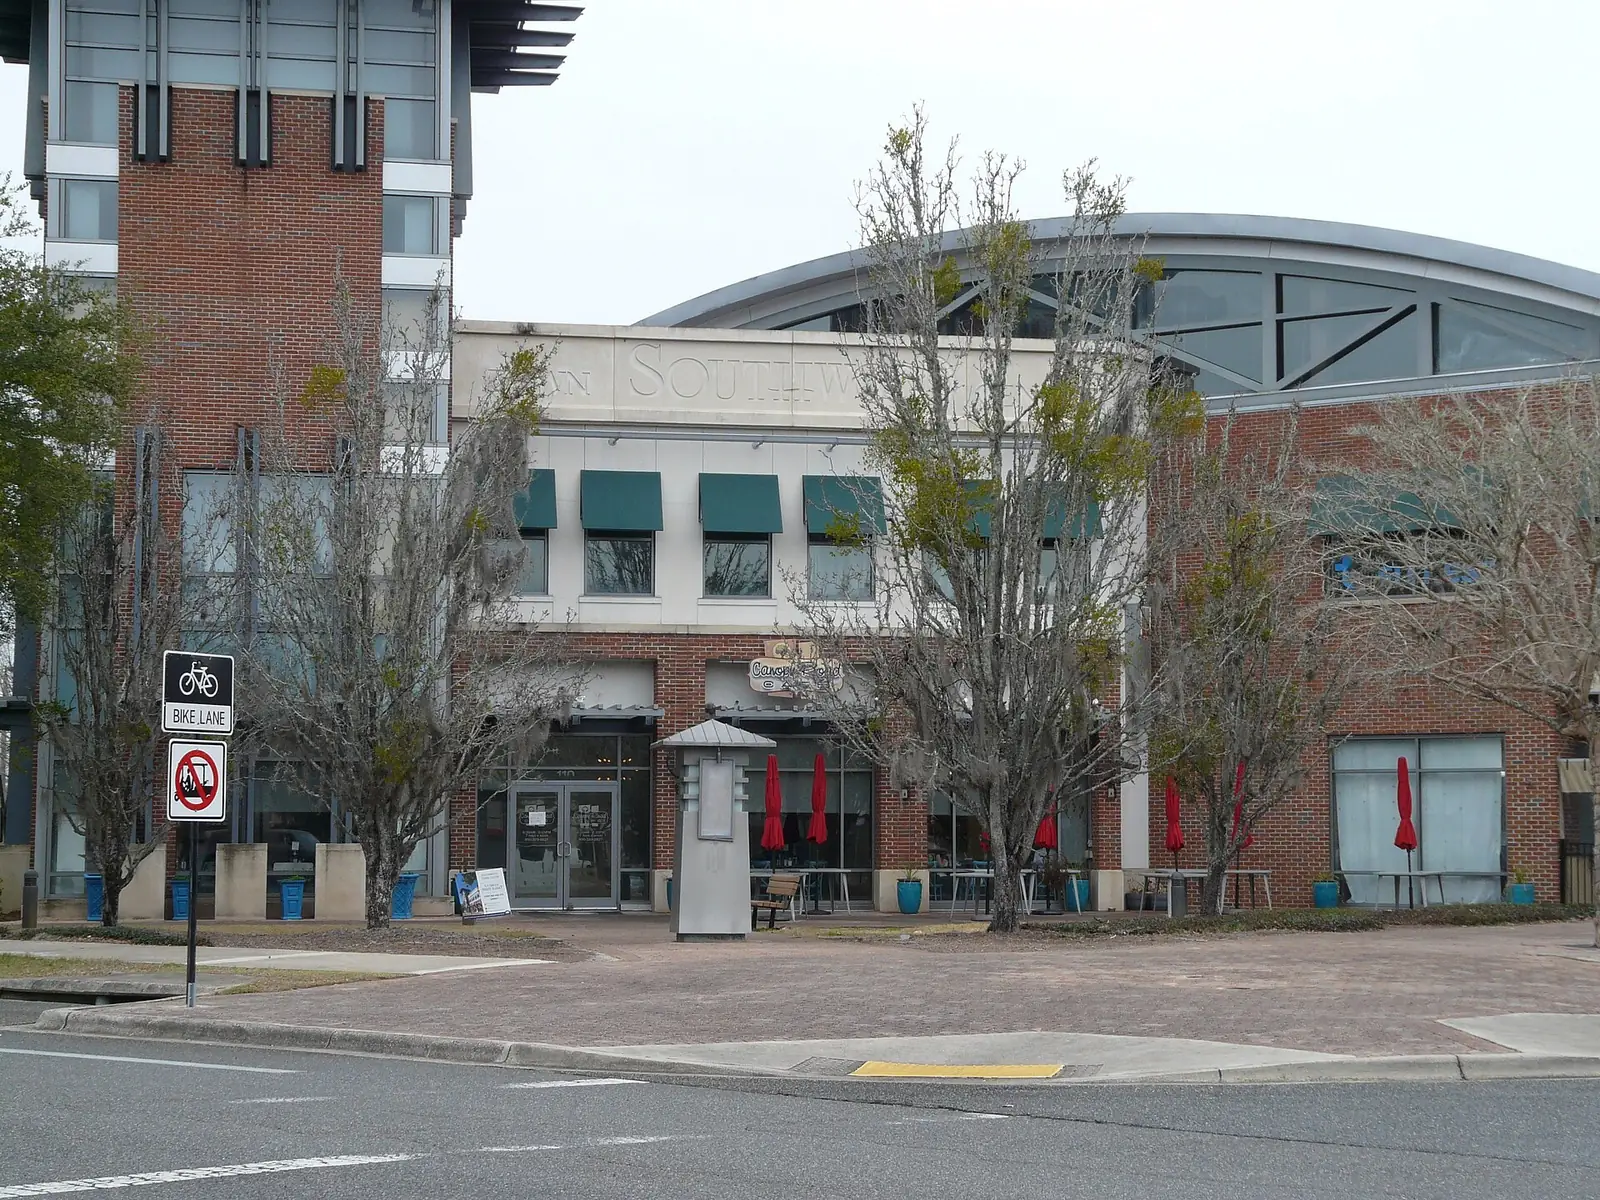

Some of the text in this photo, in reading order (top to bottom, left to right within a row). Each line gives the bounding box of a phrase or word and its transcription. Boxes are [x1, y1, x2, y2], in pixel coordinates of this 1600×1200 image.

[752, 661, 795, 680] Canop
[173, 708, 225, 726] BIKE LANE
